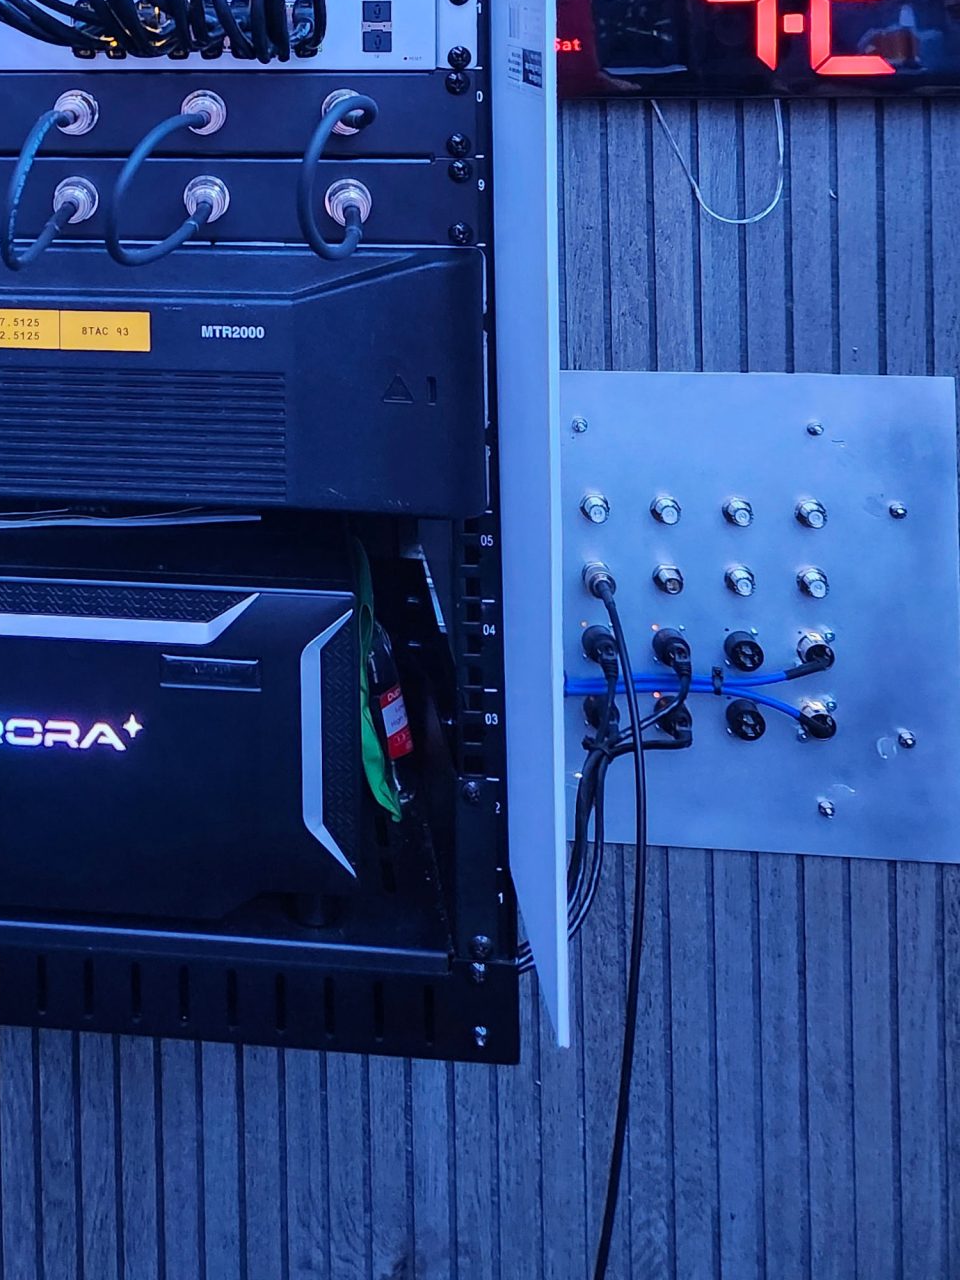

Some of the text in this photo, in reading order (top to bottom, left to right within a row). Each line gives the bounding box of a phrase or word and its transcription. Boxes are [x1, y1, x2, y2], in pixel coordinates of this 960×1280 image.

[81, 326, 130, 336] 8TAC 93
[201, 325, 265, 338] MTR2000
[480, 534, 494, 546] 05
[483, 624, 496, 636] 04
[485, 713, 498, 725] 03
